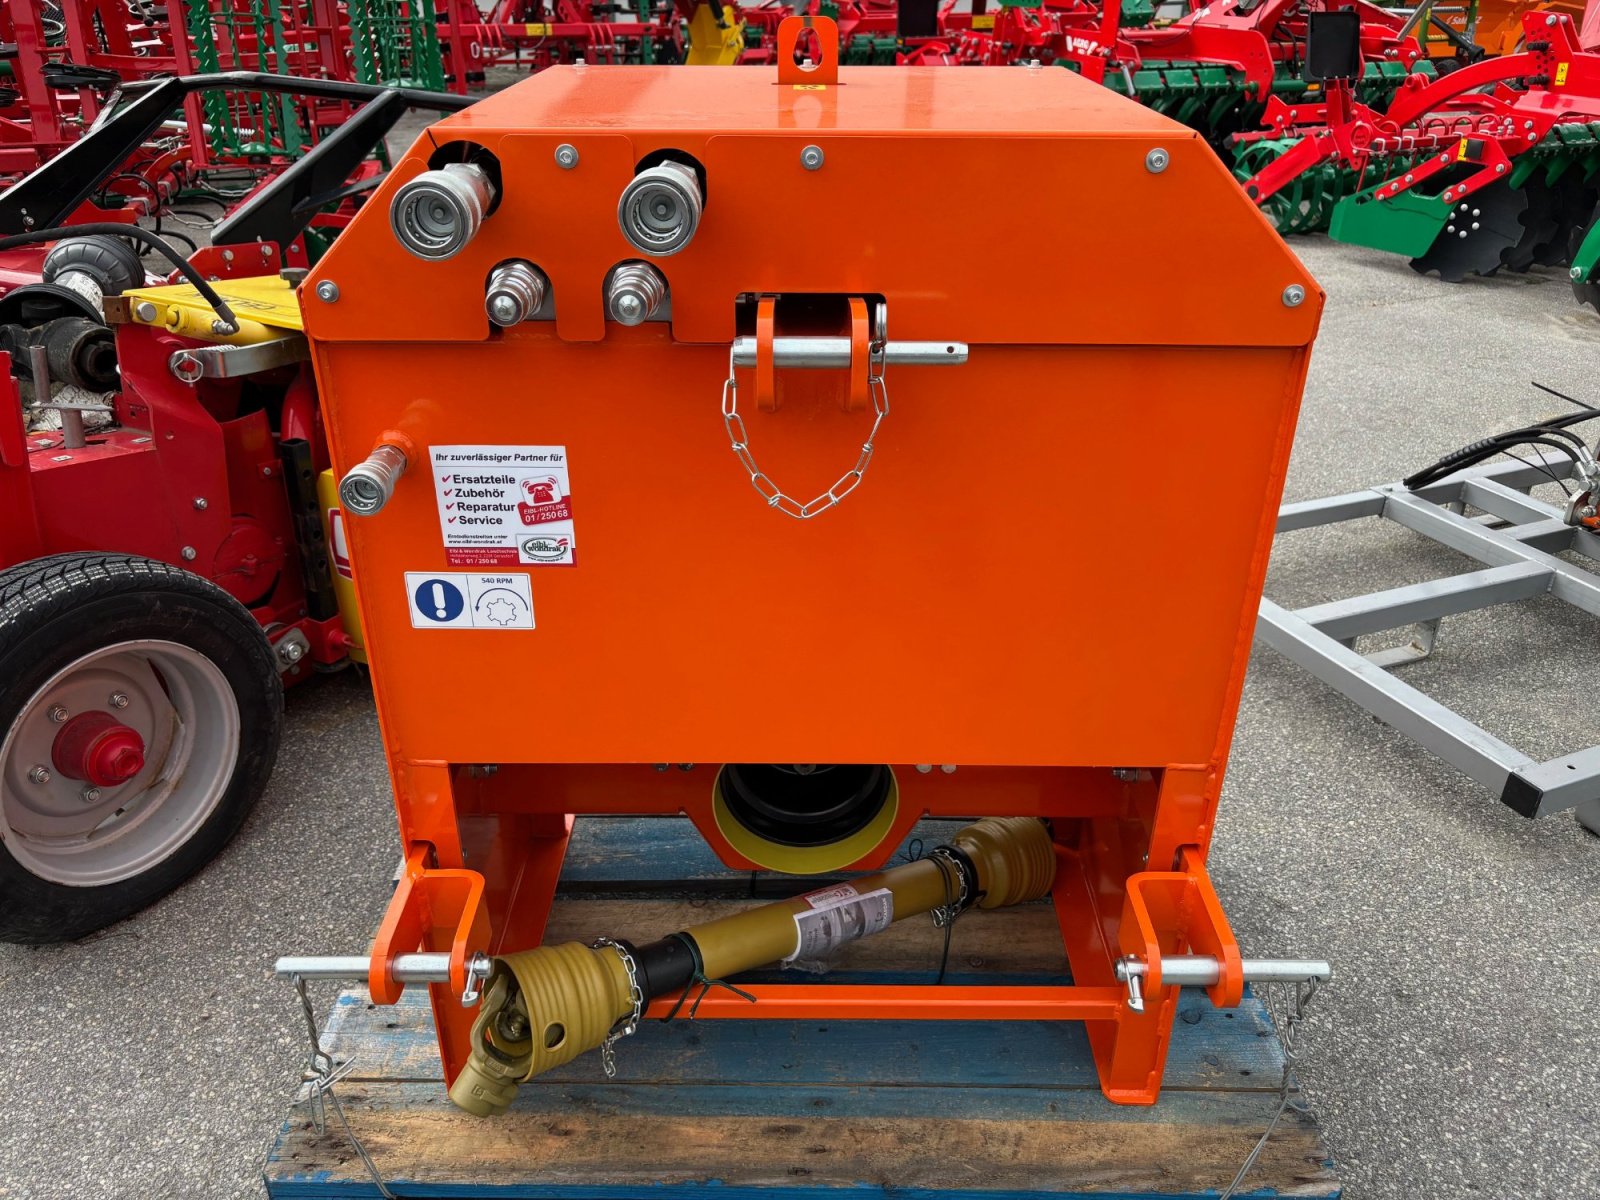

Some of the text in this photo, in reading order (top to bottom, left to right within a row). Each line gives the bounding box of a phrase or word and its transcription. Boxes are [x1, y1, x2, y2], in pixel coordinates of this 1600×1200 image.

[450, 454, 512, 462] zuverlässiger
[453, 474, 516, 484] Ersatzteile
[455, 488, 505, 498] Zubehör
[457, 502, 516, 513] Reparatur
[524, 504, 566, 514] EIBL-HOTLINE
[459, 516, 503, 525] Service
